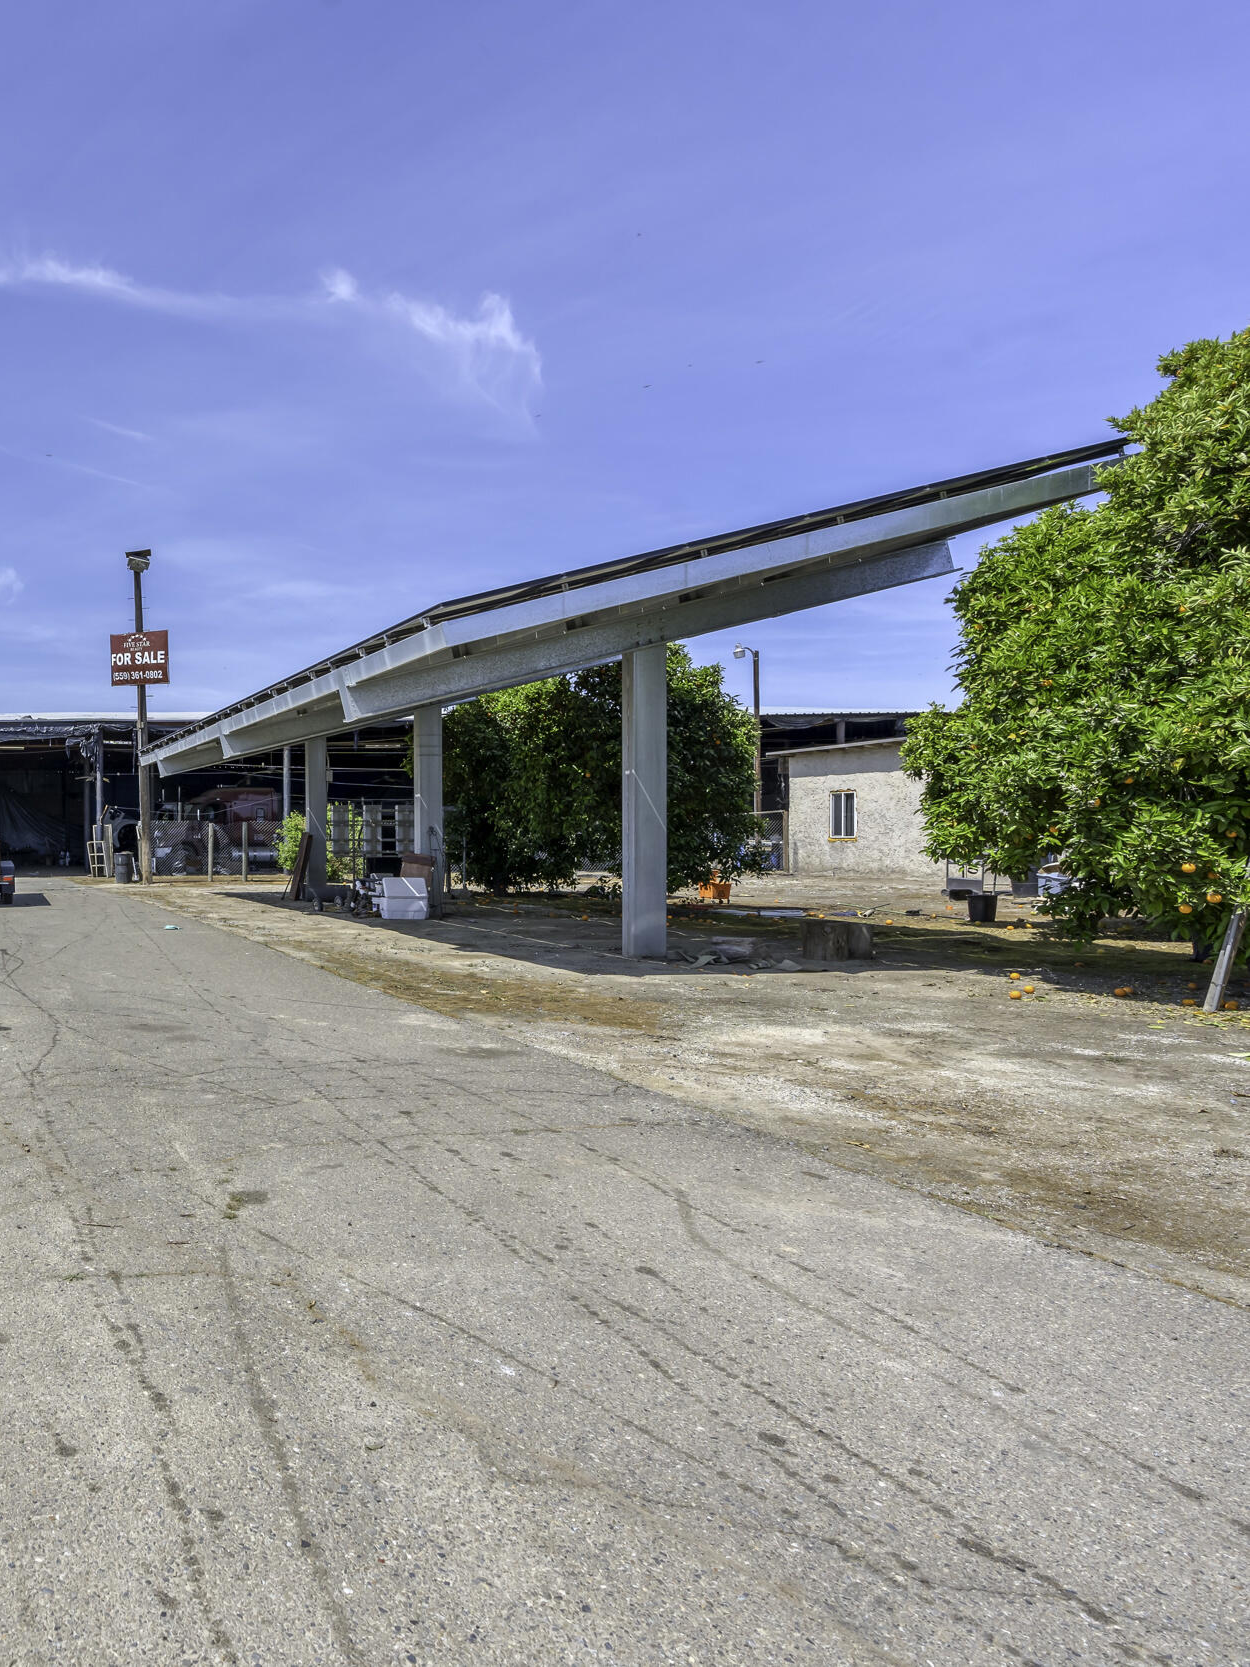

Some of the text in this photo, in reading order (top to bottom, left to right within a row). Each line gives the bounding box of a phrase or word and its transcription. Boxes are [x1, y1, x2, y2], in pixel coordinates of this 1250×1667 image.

[111, 651, 165, 666] FOR SALE
[113, 671, 162, 681] (559) 361-0802
